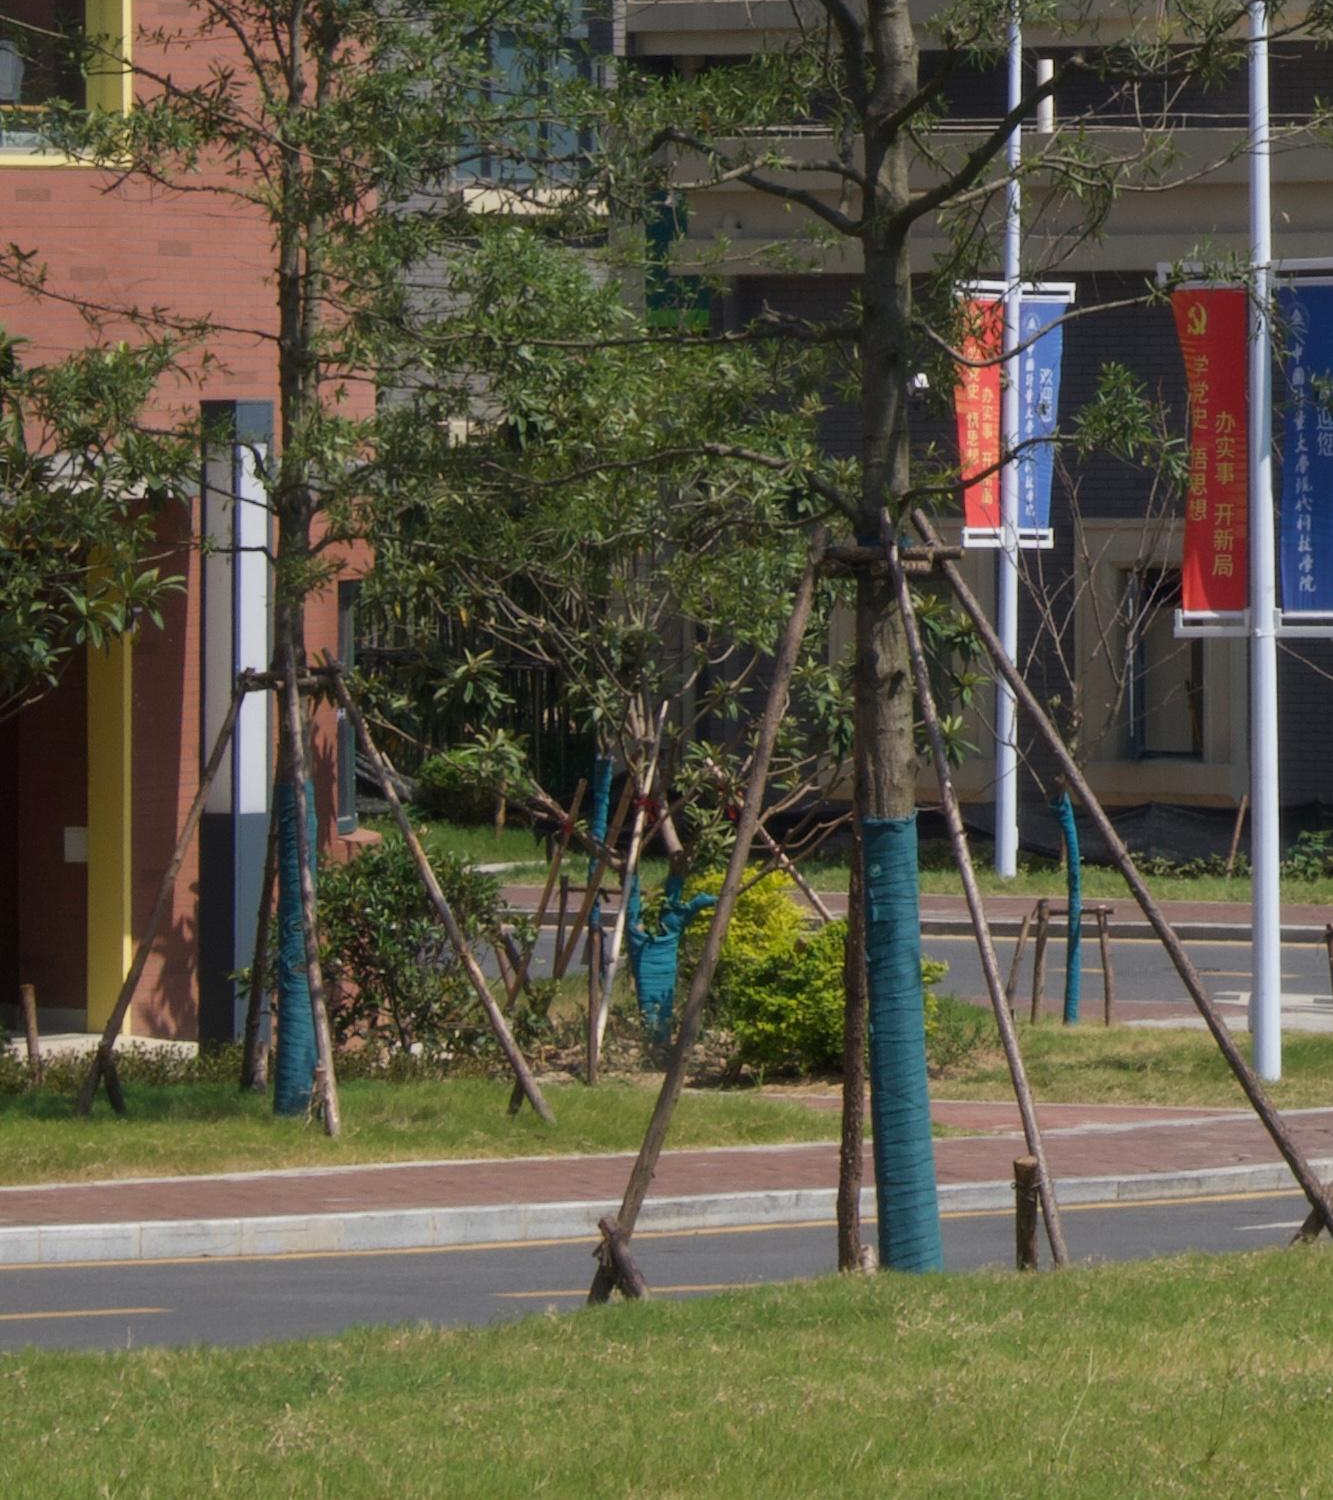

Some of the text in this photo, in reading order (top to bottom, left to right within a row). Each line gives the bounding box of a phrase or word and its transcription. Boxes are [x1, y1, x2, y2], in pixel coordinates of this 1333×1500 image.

[1212, 411, 1236, 577] 办实事 开新局
